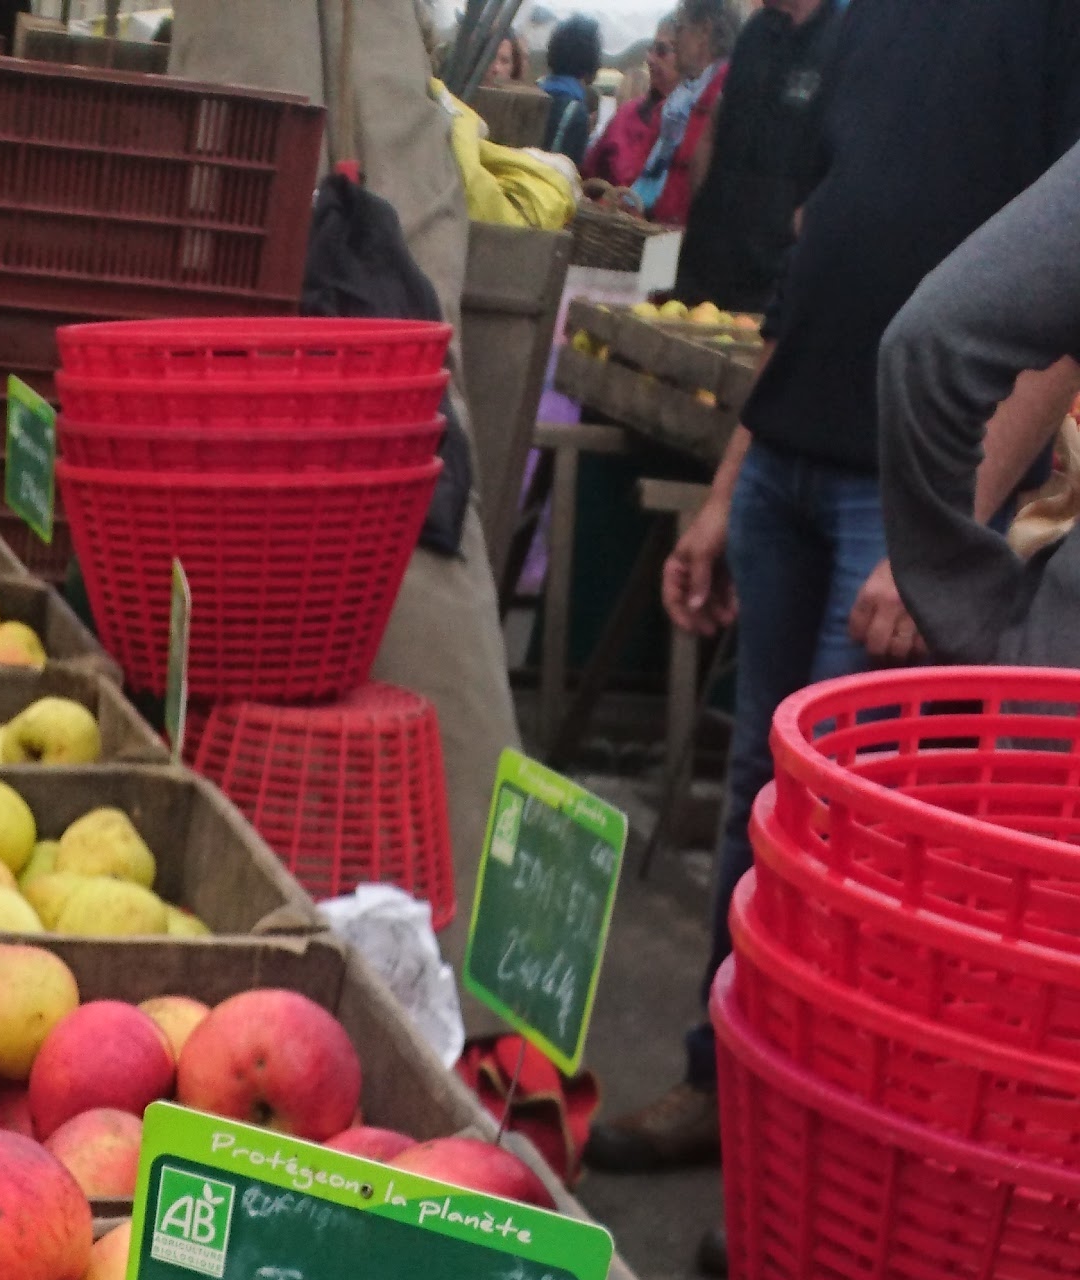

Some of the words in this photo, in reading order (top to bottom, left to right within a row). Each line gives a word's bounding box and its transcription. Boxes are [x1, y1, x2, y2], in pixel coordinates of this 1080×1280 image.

[160, 1194, 217, 1244] AB
[383, 1180, 408, 1207] la
[418, 1196, 533, 1244] planète
[152, 1244, 223, 1272] BIOLOGIQUE
[154, 1234, 224, 1260] AGRICULTURE
